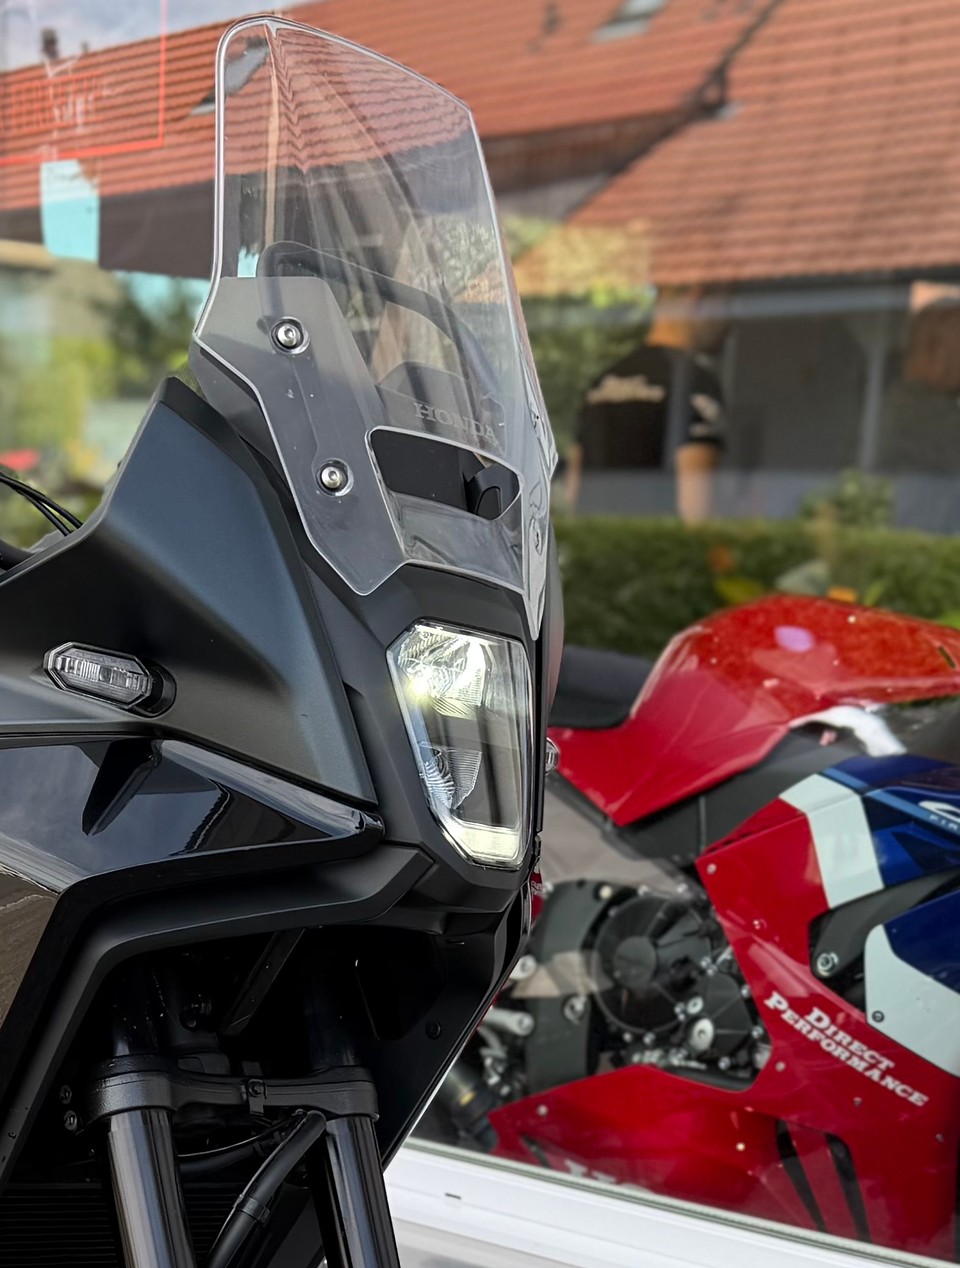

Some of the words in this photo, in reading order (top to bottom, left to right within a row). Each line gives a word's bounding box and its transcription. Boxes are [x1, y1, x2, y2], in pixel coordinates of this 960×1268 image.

[412, 401, 499, 446] HONDA
[763, 990, 930, 1107] PERFORMANCE
[805, 1006, 896, 1071] DIRECT
